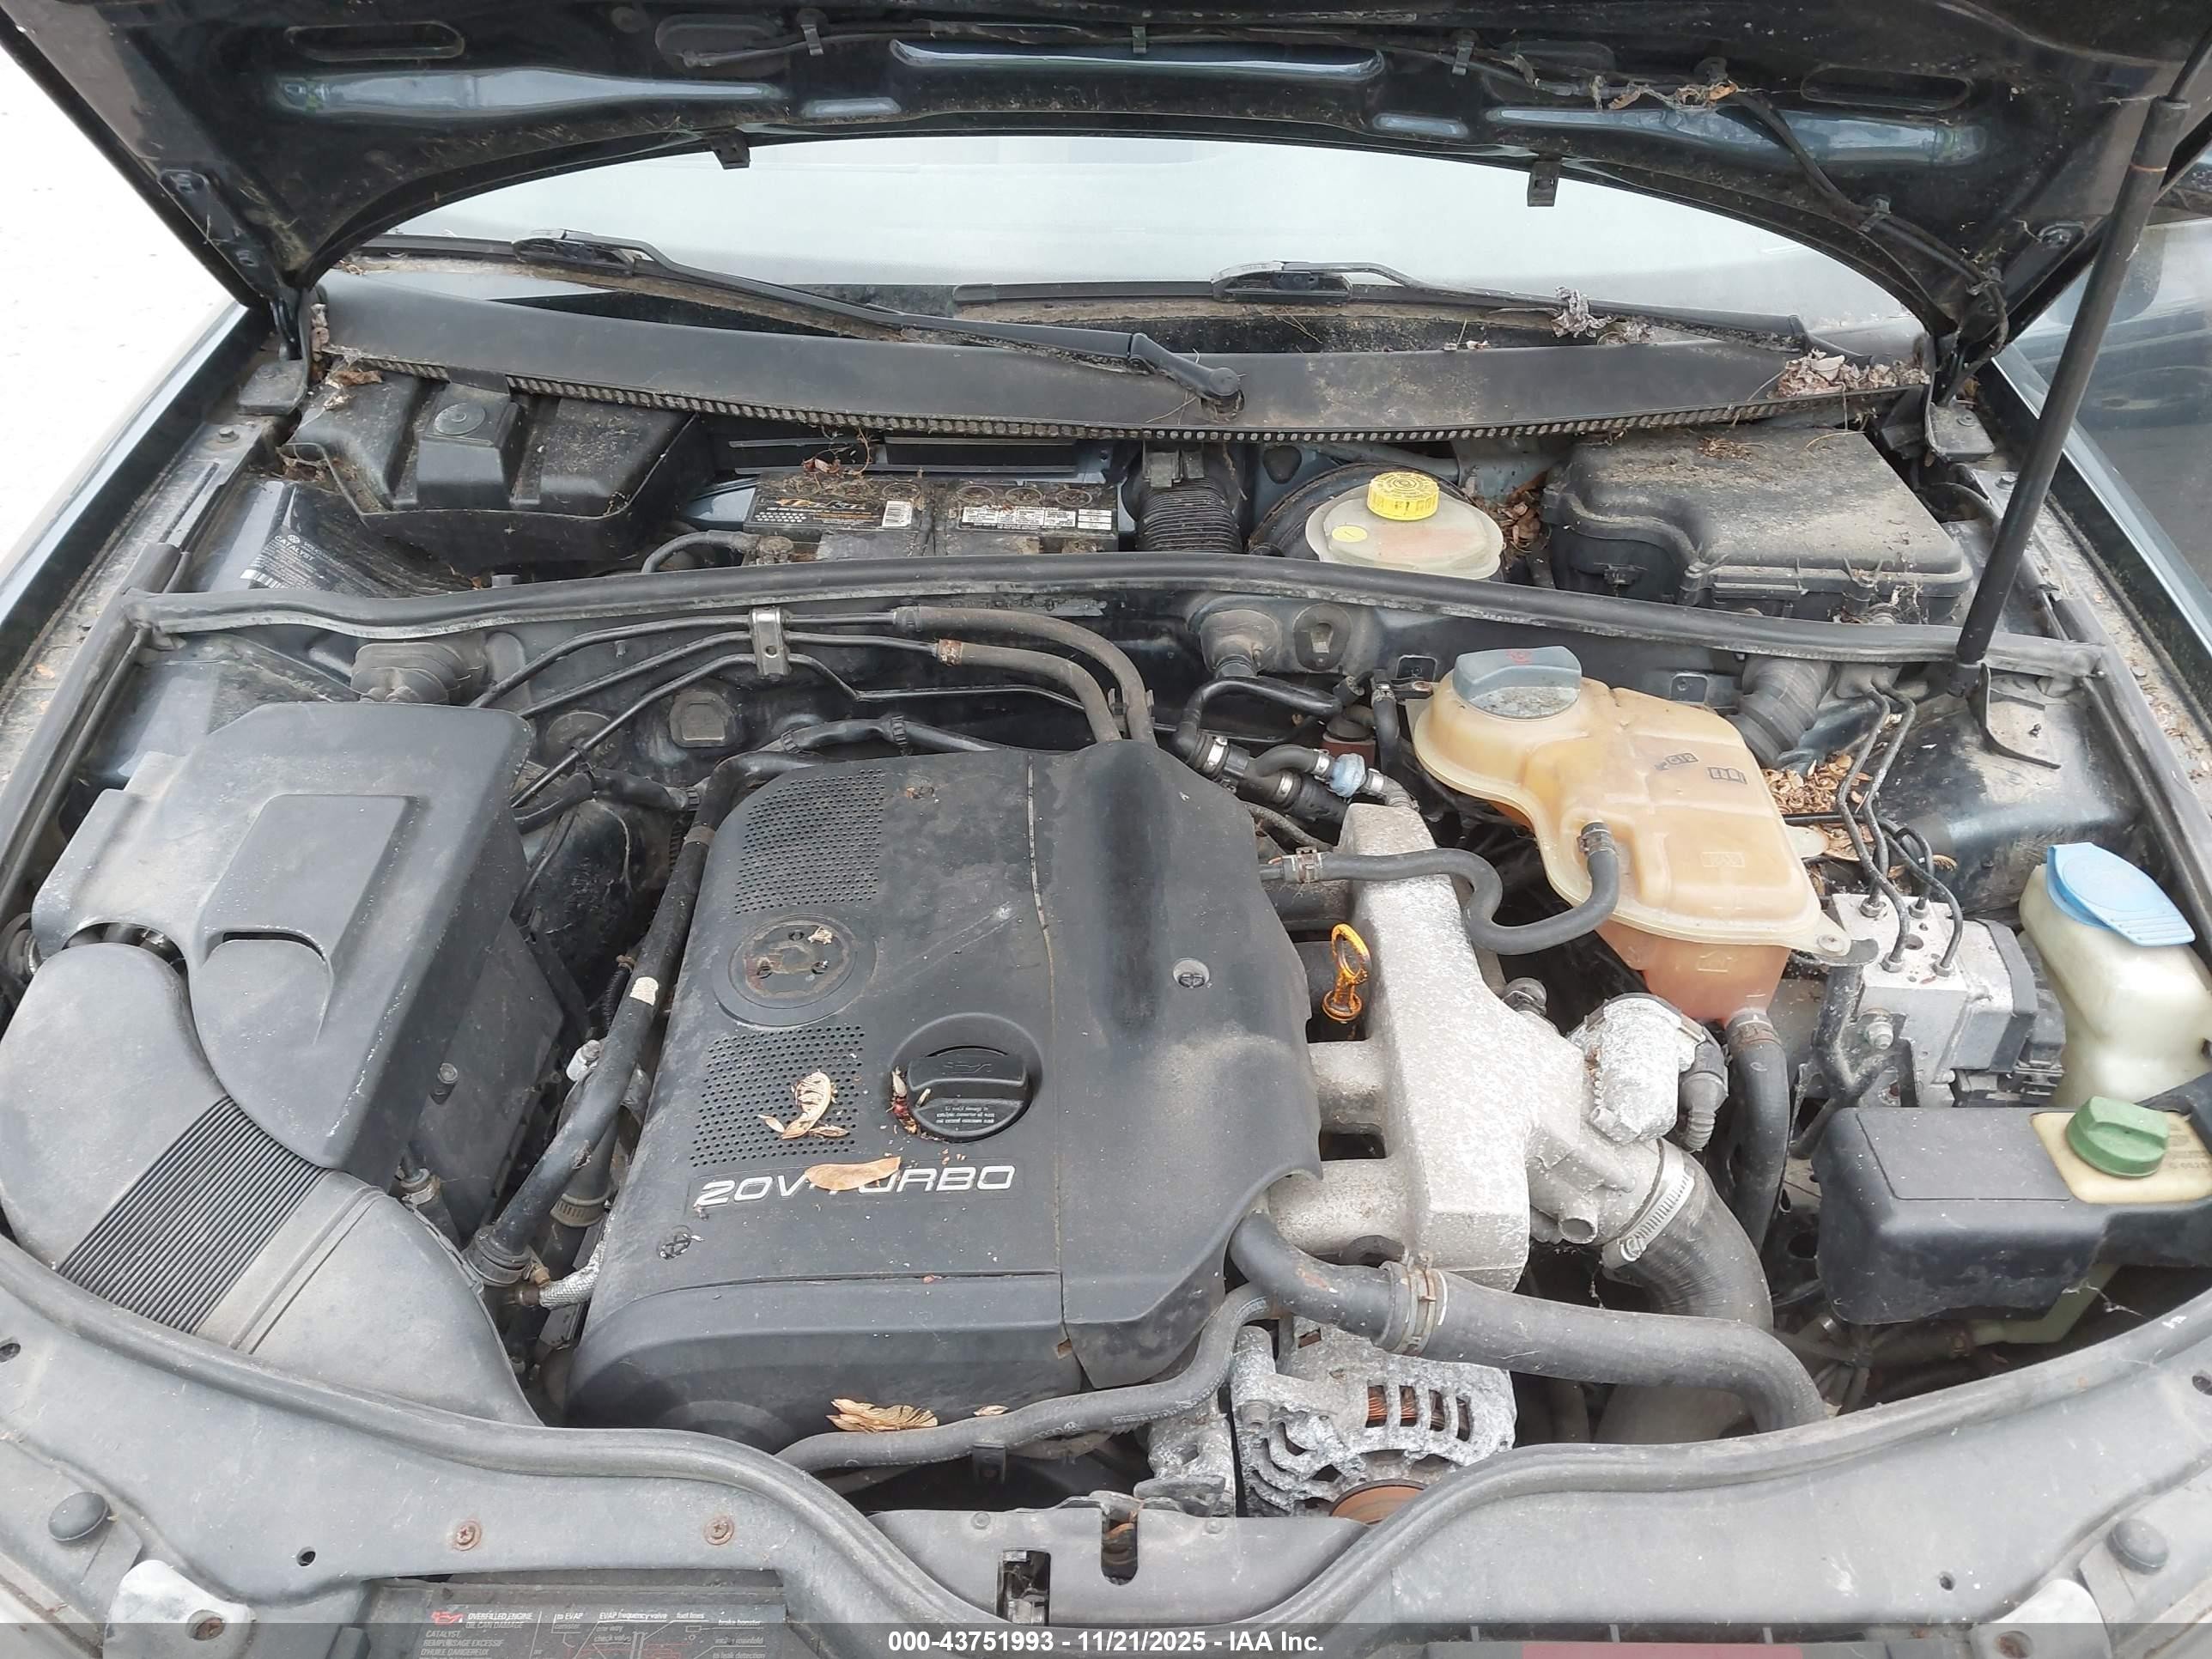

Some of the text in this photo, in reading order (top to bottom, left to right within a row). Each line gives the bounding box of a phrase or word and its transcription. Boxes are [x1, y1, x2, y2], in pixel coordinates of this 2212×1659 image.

[274, 535, 315, 561] CATALYST
[695, 1164, 1017, 1206] 20V URBO
[468, 1612, 507, 1620] OVERFILLED
[564, 1612, 584, 1620] EVAP
